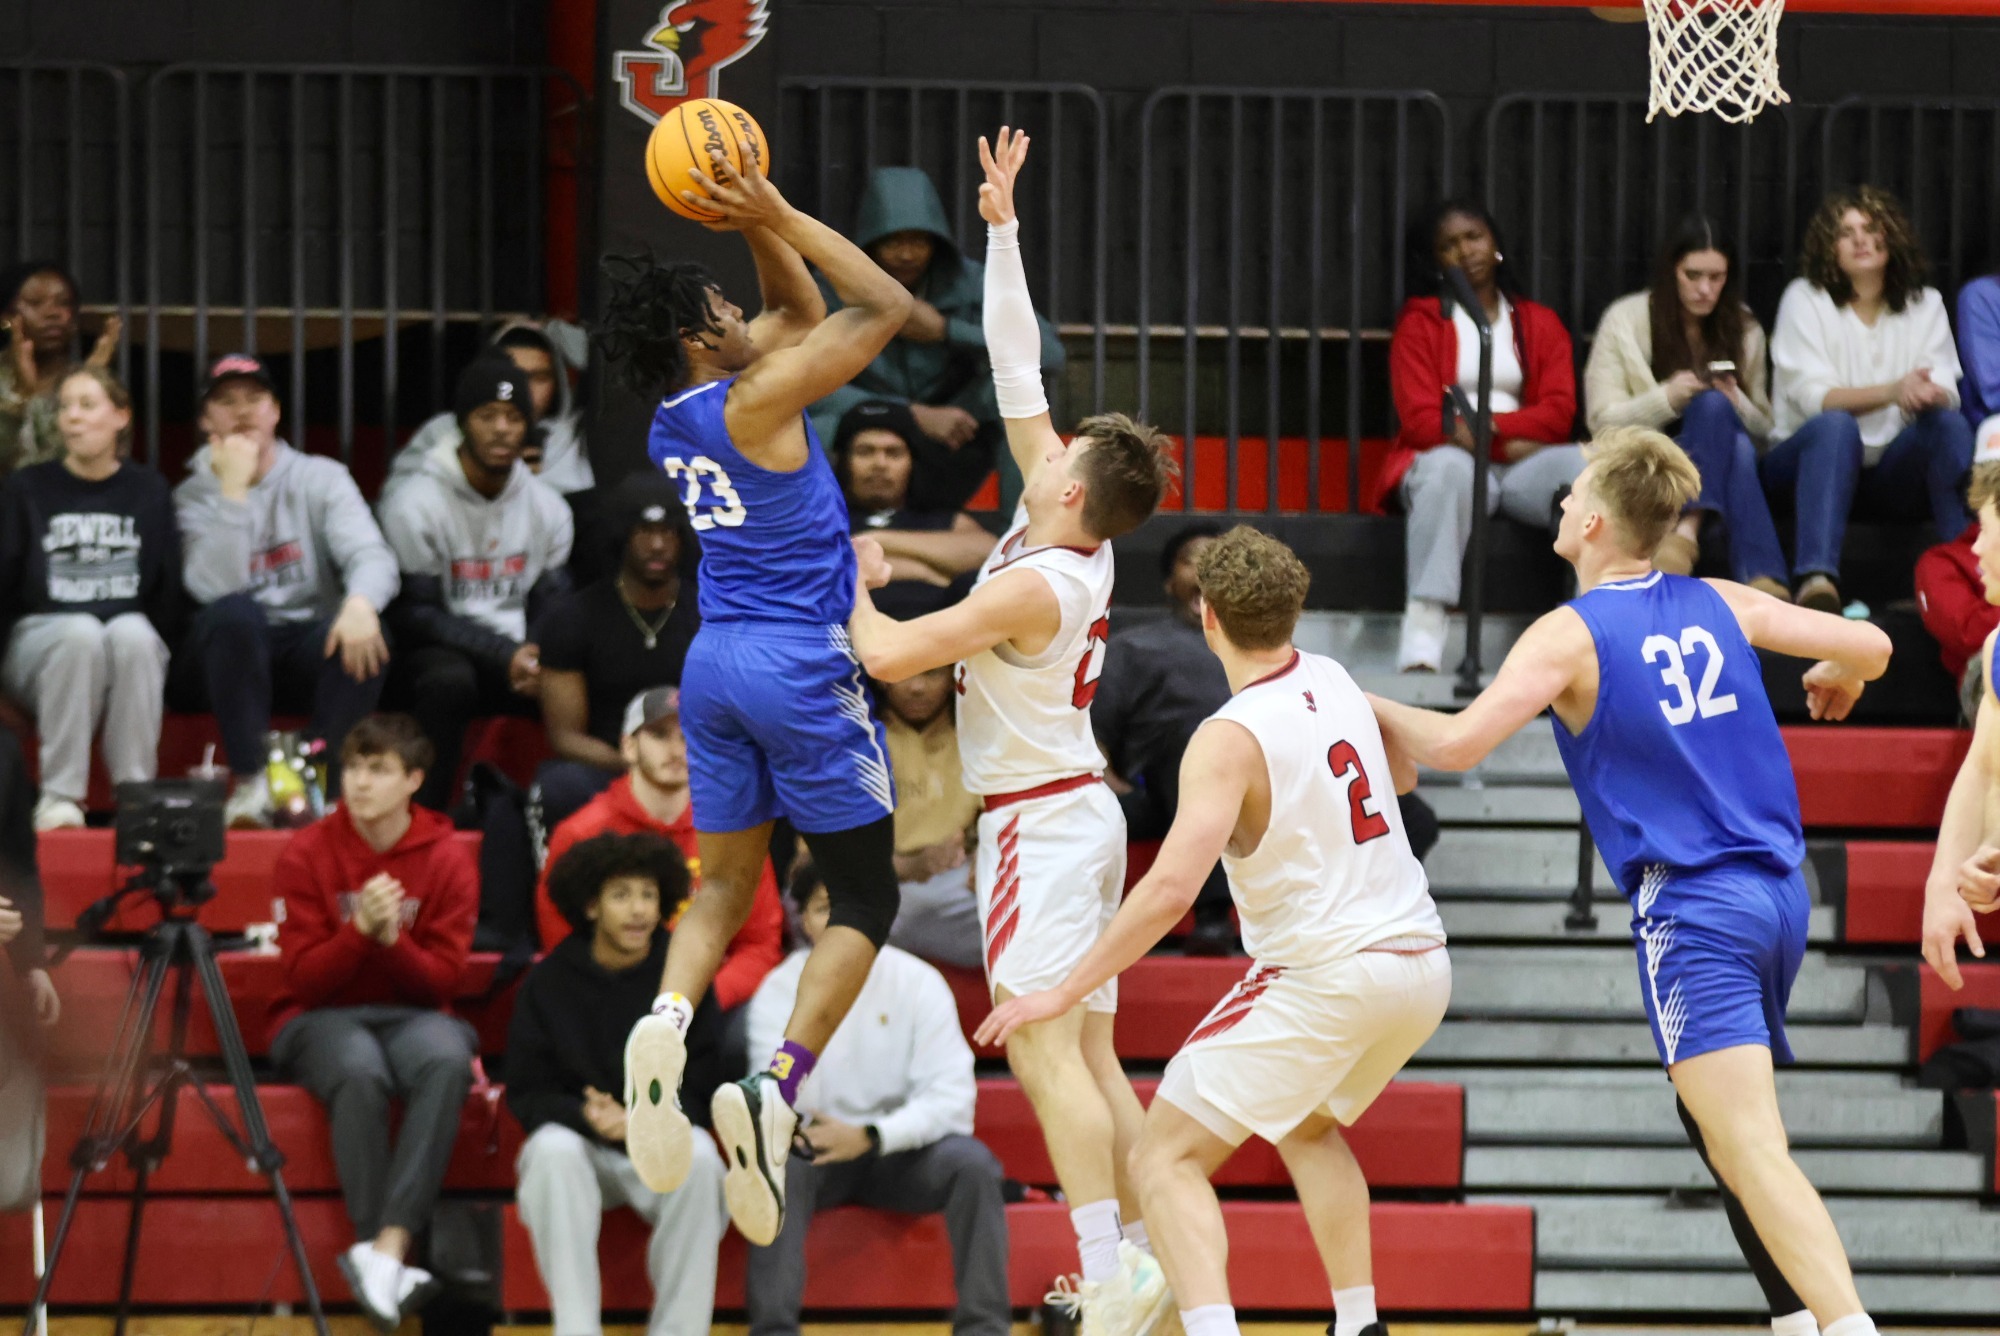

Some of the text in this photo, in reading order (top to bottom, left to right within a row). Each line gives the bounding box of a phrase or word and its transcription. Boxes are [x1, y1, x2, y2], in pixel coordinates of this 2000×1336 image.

[663, 455, 747, 531] 23
[1641, 625, 1738, 726] 32
[1327, 739, 1390, 845] 2
